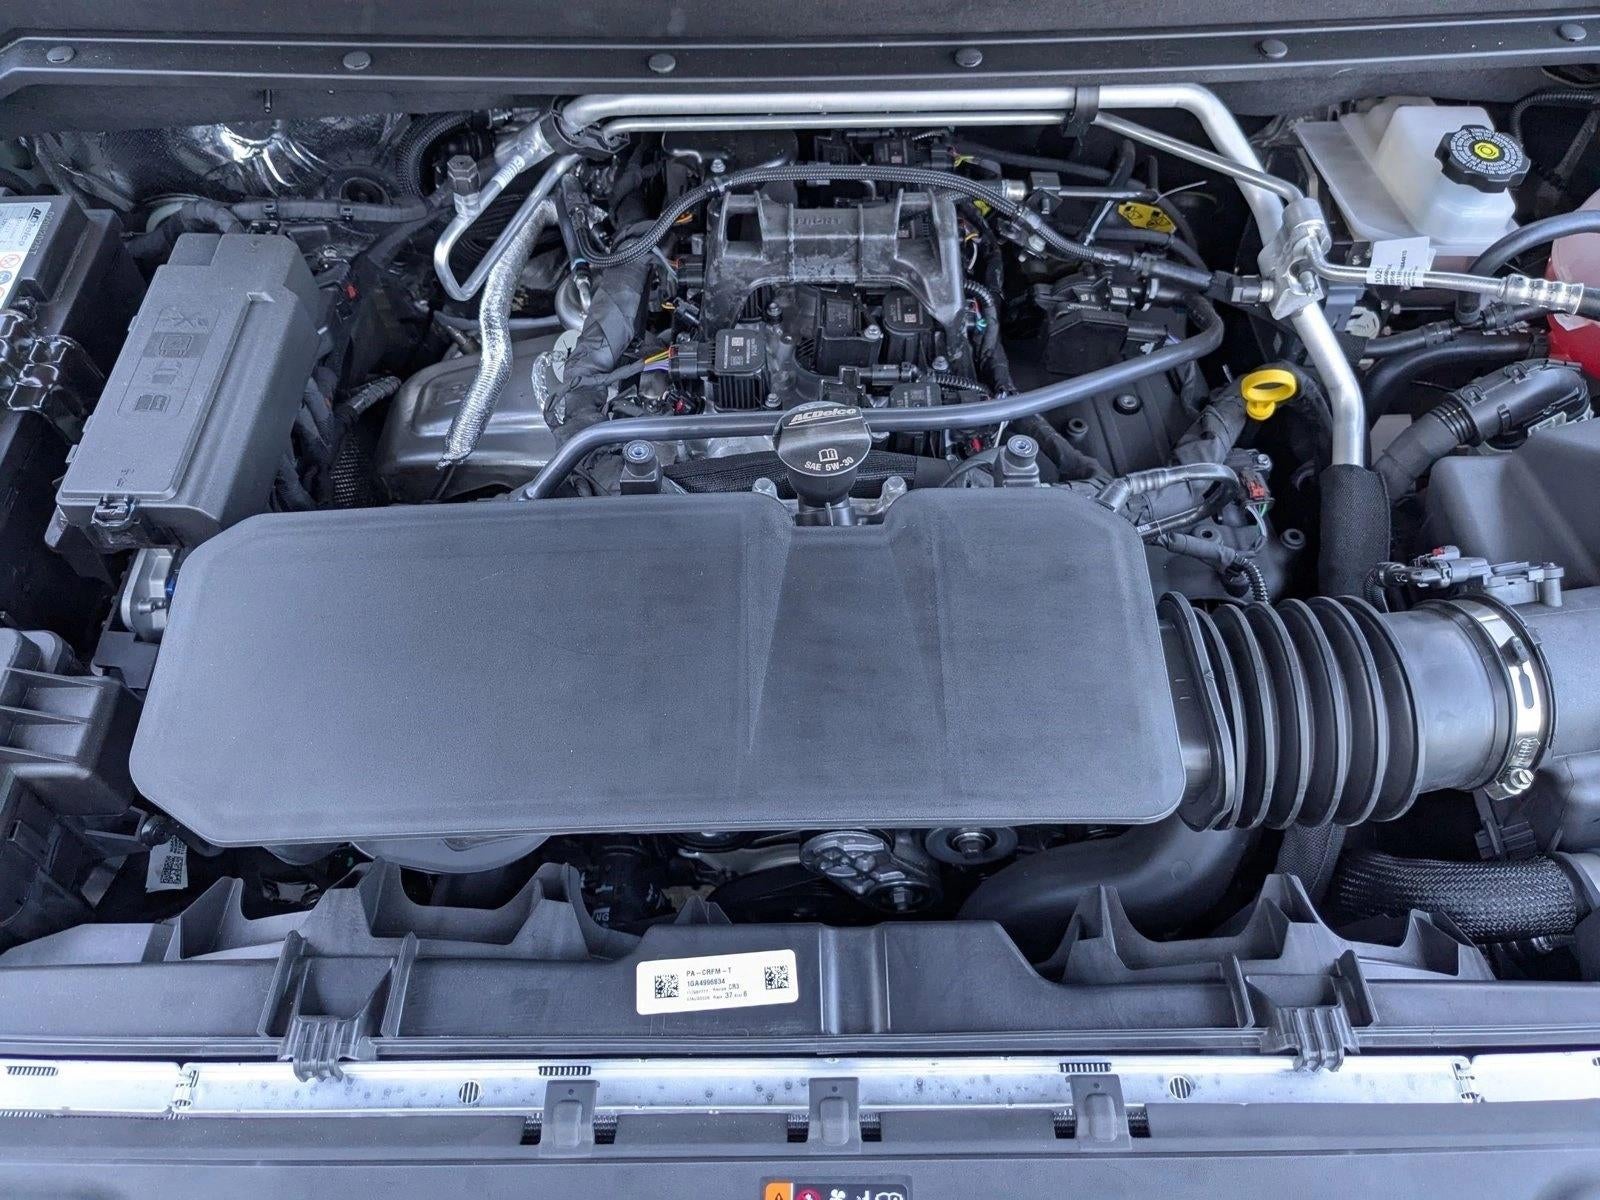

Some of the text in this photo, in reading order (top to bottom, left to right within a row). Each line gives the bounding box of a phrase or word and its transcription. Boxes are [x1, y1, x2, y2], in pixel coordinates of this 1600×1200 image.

[789, 408, 857, 424] ACDelco
[804, 456, 854, 471] SAE 5W-30
[724, 991, 733, 999] 37
